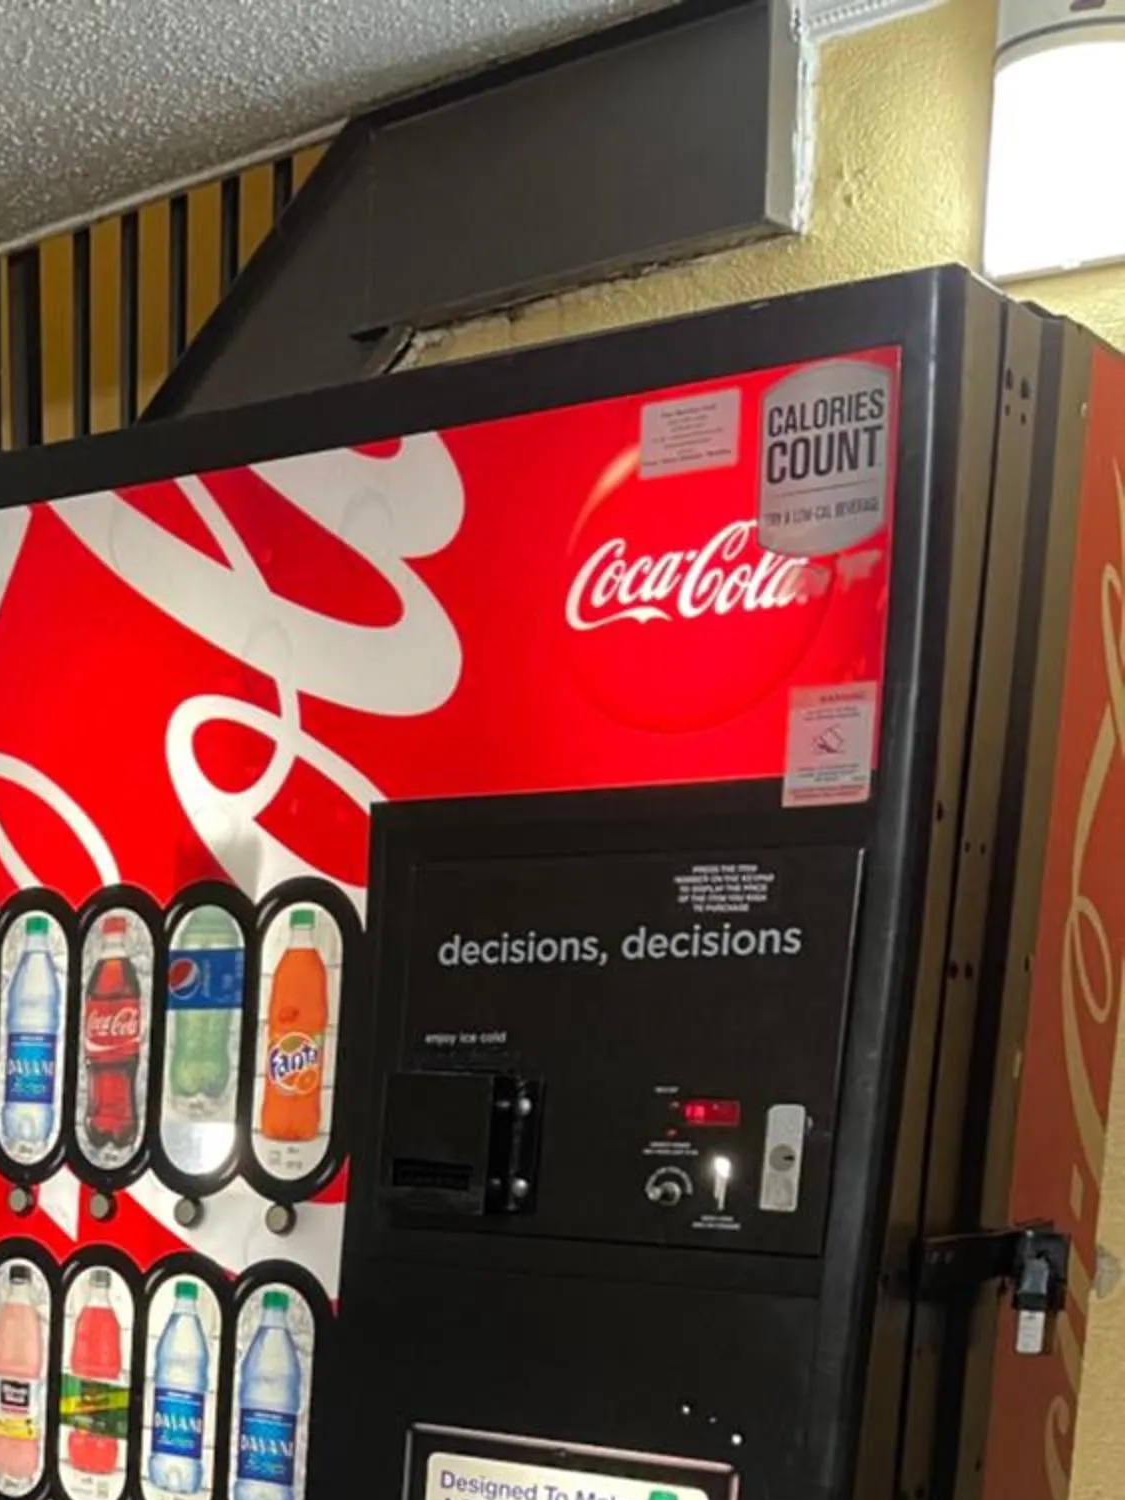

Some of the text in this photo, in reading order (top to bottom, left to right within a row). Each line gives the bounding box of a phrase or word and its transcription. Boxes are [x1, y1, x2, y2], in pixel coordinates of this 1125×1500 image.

[767, 388, 885, 438] CALORIES
[766, 423, 883, 485] COUNT
[565, 518, 809, 632] Coca-Cola
[438, 921, 802, 967] decisions, decisions
